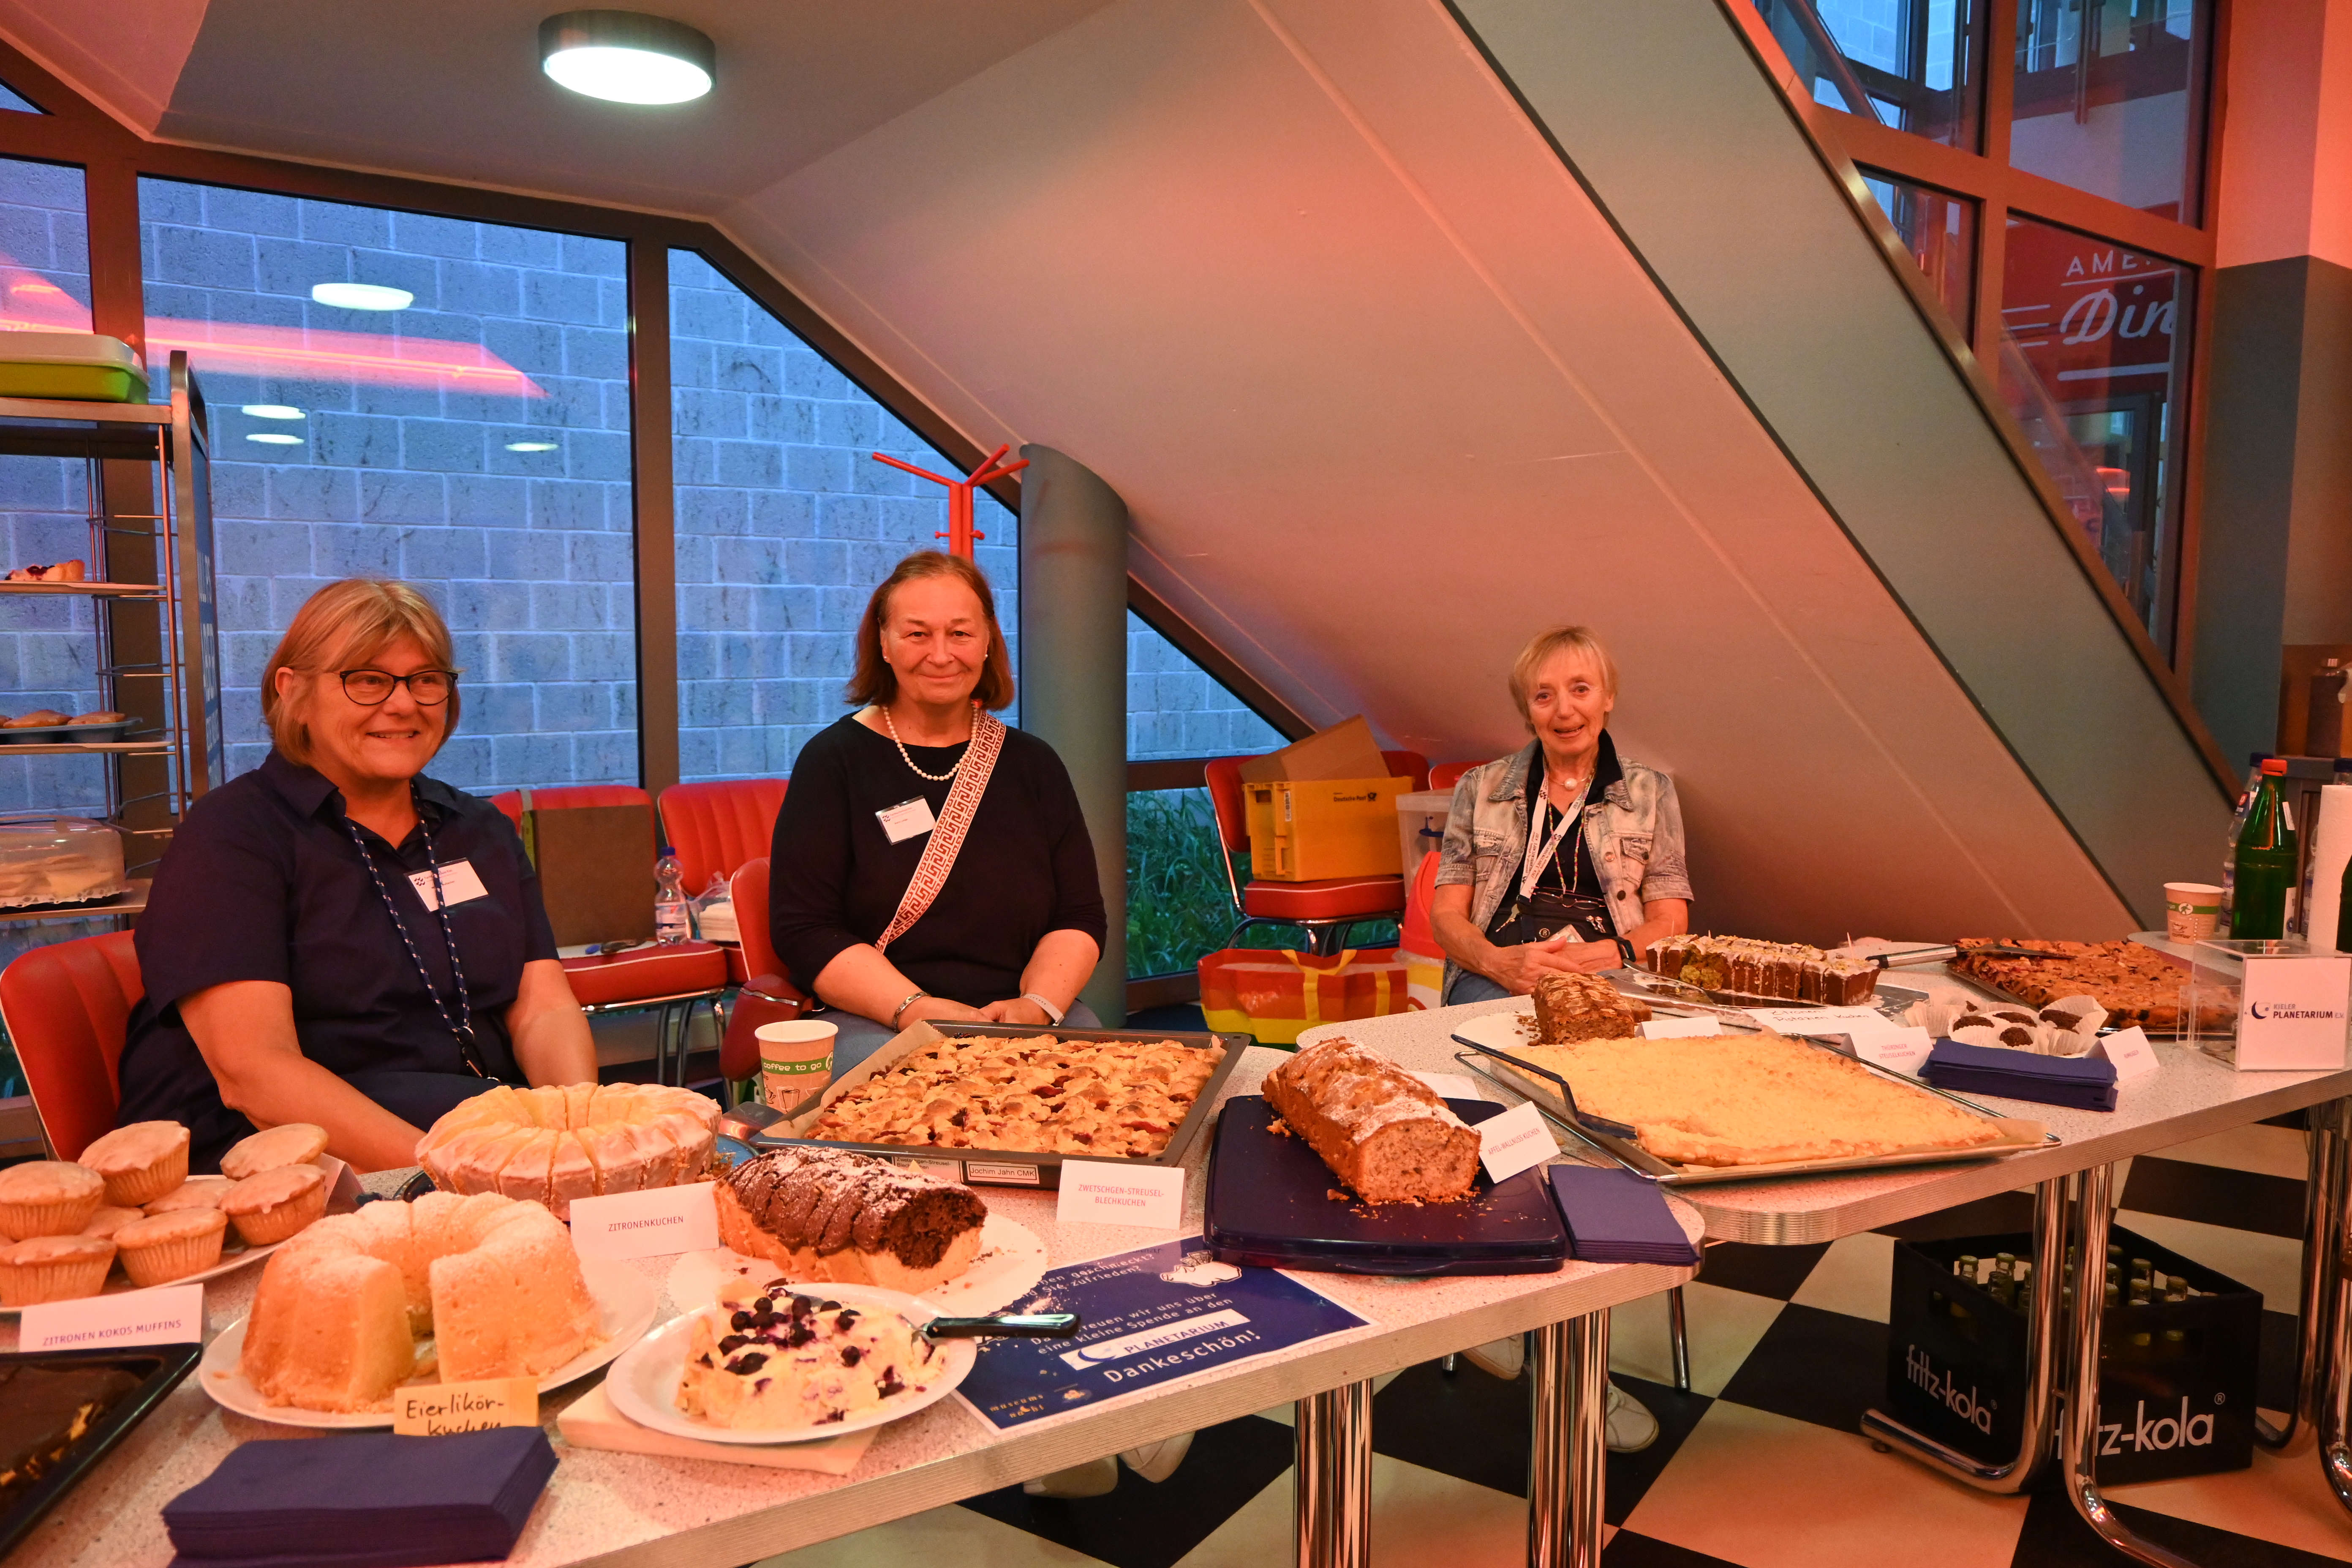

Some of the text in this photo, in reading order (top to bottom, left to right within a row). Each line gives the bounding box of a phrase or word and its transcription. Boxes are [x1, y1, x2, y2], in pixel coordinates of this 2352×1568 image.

[763, 1062, 791, 1071] coffee
[810, 1062, 822, 1070] go
[1488, 1127, 1541, 1156] APFEL-WALLNUSS KUCHEN
[970, 1167, 996, 1175] Jochim
[1078, 1184, 1165, 1197] ZWETSCHGEN-STREUSEL-
[1095, 1196, 1146, 1207] BLECHKUCHEN
[608, 1215, 683, 1232] ZITRONENKUCHEN
[1071, 1265, 1142, 1287] zufrieden?
[1129, 1308, 1152, 1319] wir
[1157, 1301, 1182, 1311] uns
[1185, 1292, 1217, 1304] über
[42, 1319, 182, 1347] ZITRONEN KOKOS MUFFINS
[1038, 1298, 1233, 1354] eine kleine Spende an den
[1124, 1320, 1231, 1354] PLANETARIUM
[1103, 1329, 1261, 1383] Dankeschön!
[1906, 1344, 1991, 1435] fritz-kola
[406, 1392, 504, 1419] Eierlikör-
